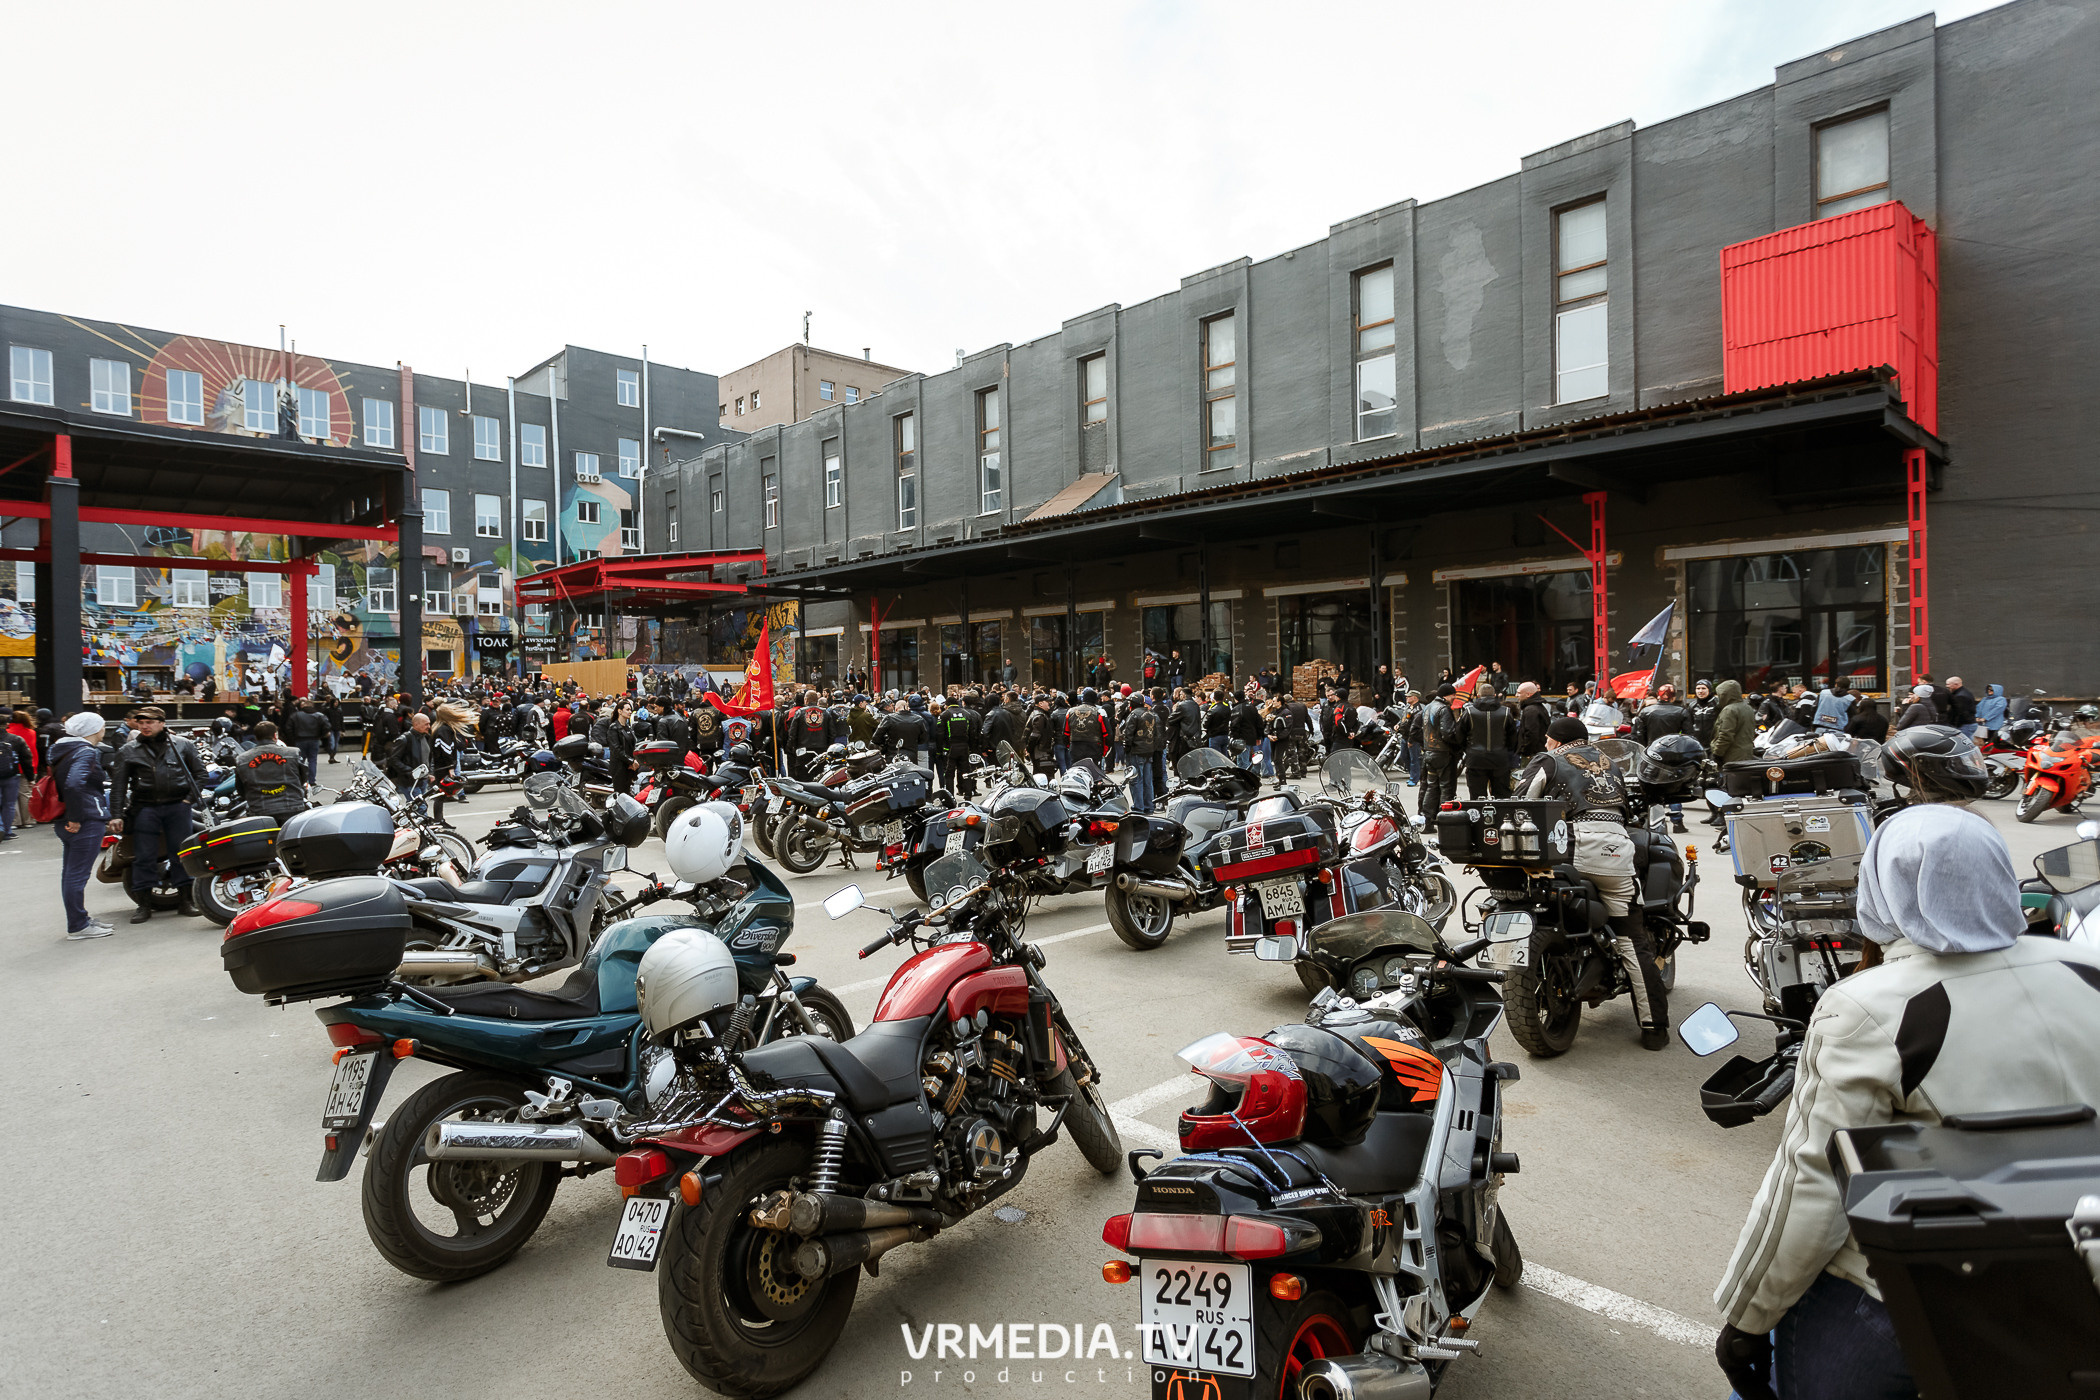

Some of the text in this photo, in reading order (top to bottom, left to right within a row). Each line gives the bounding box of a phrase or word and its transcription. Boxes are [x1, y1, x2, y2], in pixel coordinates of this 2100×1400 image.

[1486, 830, 1496, 838] 42
[1102, 858, 1111, 867] 42
[1772, 857, 1788, 866] 42
[1265, 885, 1293, 900] 6845
[1287, 901, 1302, 913] 42
[740, 929, 777, 942] Diversion
[761, 942, 775, 951] 900
[341, 1058, 368, 1083] 1195
[346, 1091, 362, 1113] 42
[1152, 1186, 1195, 1194] HONDA
[1270, 1187, 1330, 1202] ADVANCED SUPER SPORT
[628, 1201, 662, 1224] 0470
[640, 1224, 651, 1234] RUS
[637, 1235, 656, 1259] 42
[1155, 1268, 1232, 1309] 2249
[1195, 1309, 1225, 1326] RUS
[1204, 1327, 1245, 1369] 42
